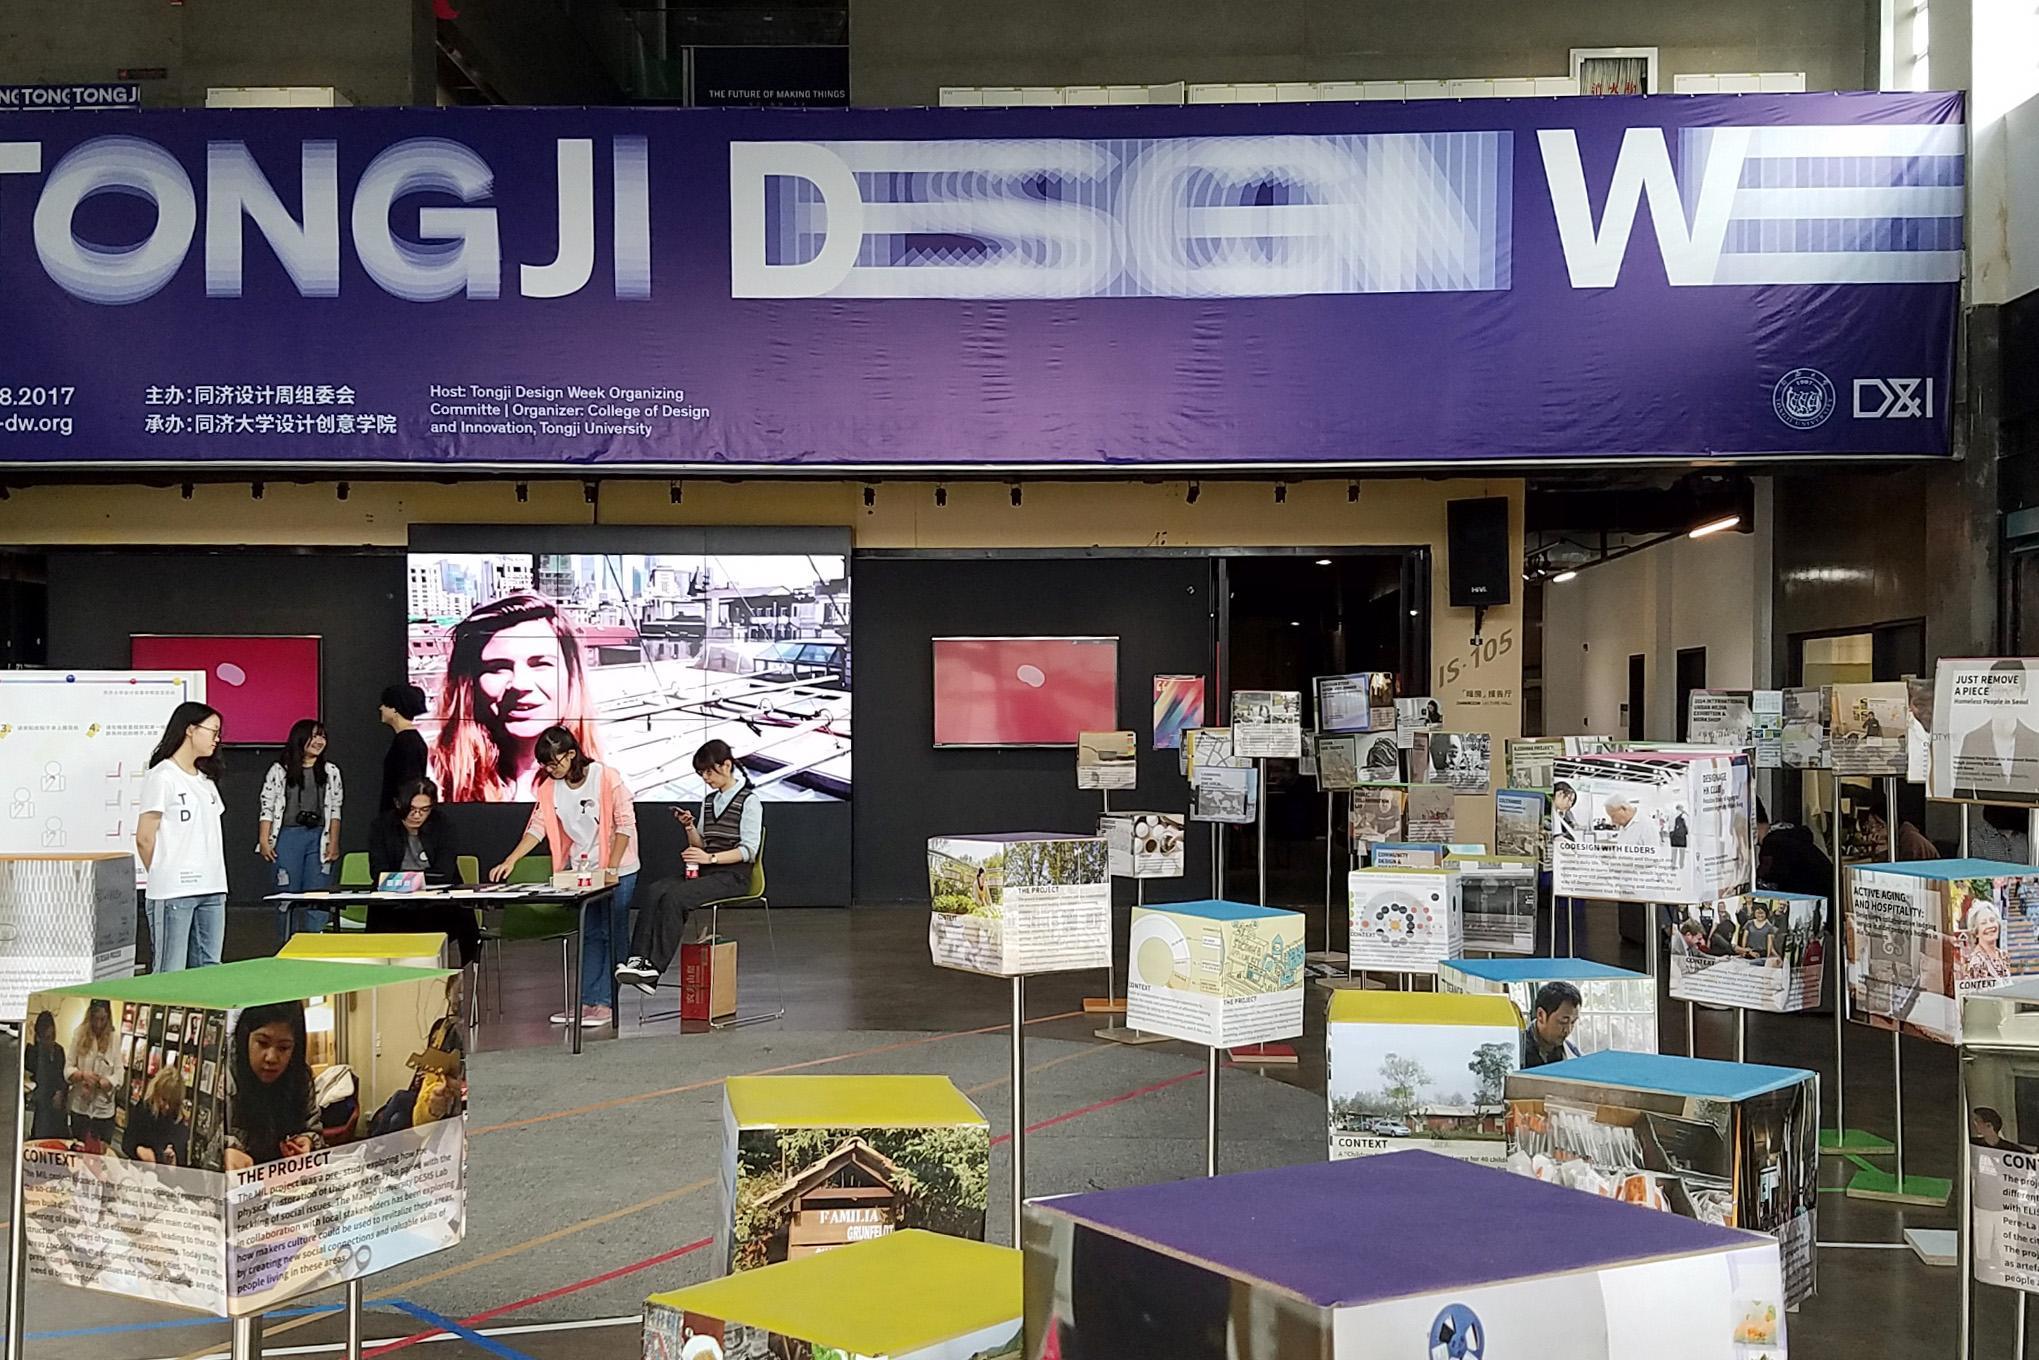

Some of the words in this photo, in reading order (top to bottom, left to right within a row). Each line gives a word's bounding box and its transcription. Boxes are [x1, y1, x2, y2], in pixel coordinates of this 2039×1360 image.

[708, 89, 726, 98] THE
[728, 89, 761, 98] FUTURE
[763, 89, 775, 98] OF
[776, 89, 811, 98] MAKING
[813, 89, 846, 98] THINGS
[430, 384, 466, 398] Host:
[470, 385, 512, 401] Tongji
[515, 385, 564, 401] Design
[567, 386, 606, 400] Week
[608, 387, 685, 402] Organizing
[430, 403, 500, 417] Committe
[512, 404, 585, 419] Organizer:
[587, 405, 641, 420] College
[644, 405, 659, 418] of
[662, 405, 711, 421] Design
[430, 421, 457, 434] and
[460, 421, 538, 437] Innovation,
[539, 422, 581, 438] Tongji
[584, 422, 653, 438] University
[1955, 675, 1979, 684] JUST
[1980, 674, 2020, 685] REMOVE
[1954, 687, 1961, 696] A
[1962, 686, 1990, 696] PIECE
[1983, 698, 2003, 706] People
[178, 793, 187, 806] T
[180, 809, 192, 822] D
[1560, 842, 1600, 852] CODESIGN
[1601, 844, 1623, 852] WITH
[1624, 845, 1656, 854] ELDERS
[1018, 887, 1030, 895] THE
[1031, 886, 1059, 894] PROJECT
[1853, 885, 1881, 899] ACTIVE
[1881, 890, 1907, 903] AGING
[1854, 899, 1870, 910] AND
[1871, 900, 1926, 919] HOSPITALITY:
[1959, 979, 1997, 991] CONTEXT
[1223, 998, 1234, 1006] THE
[1234, 996, 1257, 1005] PROJECT
[1338, 1138, 1388, 1149] CONTEXT
[23, 1148, 76, 1168] CONTEXT
[2002, 1153, 2039, 1172] CON
[237, 1167, 265, 1186] THE
[268, 1150, 332, 1179] PROJECT
[237, 1192, 254, 1202] The
[269, 1179, 300, 1196] project
[300, 1174, 318, 1186] was
[343, 1163, 366, 1175] study
[366, 1153, 400, 1170] exploring
[400, 1150, 416, 1160] how
[237, 1202, 269, 1220] physical
[270, 1189, 318, 1208] restoration
[318, 1186, 328, 1196] of
[328, 1182, 351, 1194] these
[352, 1177, 374, 1188] areas
[422, 1156, 440, 1167] with
[440, 1153, 453, 1163] the
[2002, 1173, 2020, 1185] The
[2020, 1178, 2039, 1190] proj
[271, 1213, 280, 1224] of
[280, 1204, 306, 1220] social
[334, 1195, 351, 1208] The
[413, 1171, 435, 1184] DESIS
[435, 1167, 449, 1179] Lab
[237, 1238, 246, 1248] in
[246, 1224, 301, 1245] collaboration
[302, 1217, 322, 1230] with
[322, 1210, 342, 1224] local
[343, 1198, 391, 1219] stakeholders
[391, 1193, 404, 1205] has
[404, 1189, 422, 1201] been
[422, 1180, 455, 1197] exploring
[819, 1208, 879, 1225] FAMILIA
[2002, 1203, 2022, 1214] with
[237, 1253, 255, 1264] how
[255, 1242, 286, 1258] makers
[286, 1233, 317, 1250] culture
[318, 1226, 341, 1240] could
[341, 1223, 352, 1234] be
[353, 1218, 372, 1231] used
[372, 1215, 381, 1225] to
[381, 1205, 413, 1222] revitalize
[413, 1199, 433, 1212] these
[2002, 1216, 2037, 1231] Pere-La
[237, 1269, 247, 1280] by
[248, 1257, 283, 1275] creating
[283, 1254, 301, 1265] new
[302, 1245, 327, 1259] social
[327, 1232, 375, 1252] connections
[375, 1225, 390, 1238] and
[390, 1216, 419, 1233] valuable
[419, 1210, 438, 1224] skills
[438, 1207, 447, 1218] of
[2002, 1231, 2012, 1240] of
[2013, 1233, 2029, 1243] the
[2003, 1244, 2021, 1256] The
[2004, 1260, 2015, 1268] as
[237, 1278, 267, 1295] people
[266, 1269, 290, 1285] living
[289, 1267, 299, 1278] in
[299, 1260, 324, 1275] these
[2004, 1274, 2036, 1286] people
